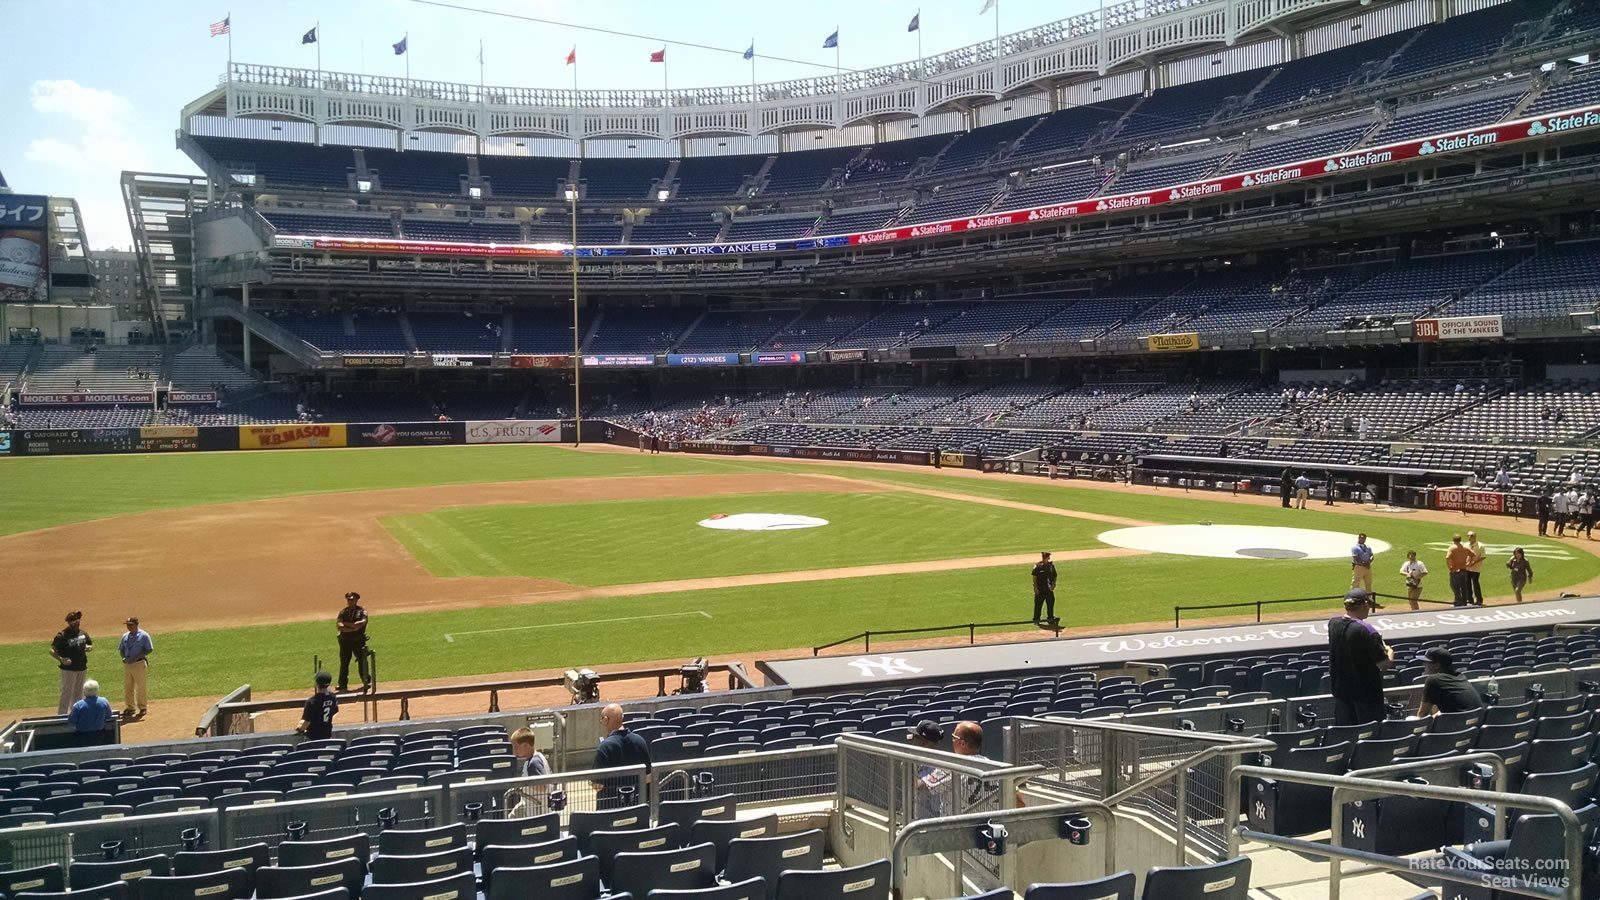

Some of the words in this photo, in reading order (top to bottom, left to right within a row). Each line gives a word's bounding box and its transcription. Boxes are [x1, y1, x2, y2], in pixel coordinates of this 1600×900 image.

[1548, 111, 1600, 133] StateFa
[719, 243, 777, 253] YANKEES
[1417, 323, 1437, 336] JBL
[1153, 336, 1193, 346] Nathan's
[470, 428, 491, 437] U.S.
[494, 426, 534, 436] TRUST
[1082, 634, 1264, 652] Welcome
[1260, 629, 1302, 639] to
[1437, 607, 1576, 625] Stadium
[848, 657, 924, 677] NY
[323, 707, 330, 722] 2
[1256, 800, 1266, 820] NY
[1352, 817, 1365, 839] NY
